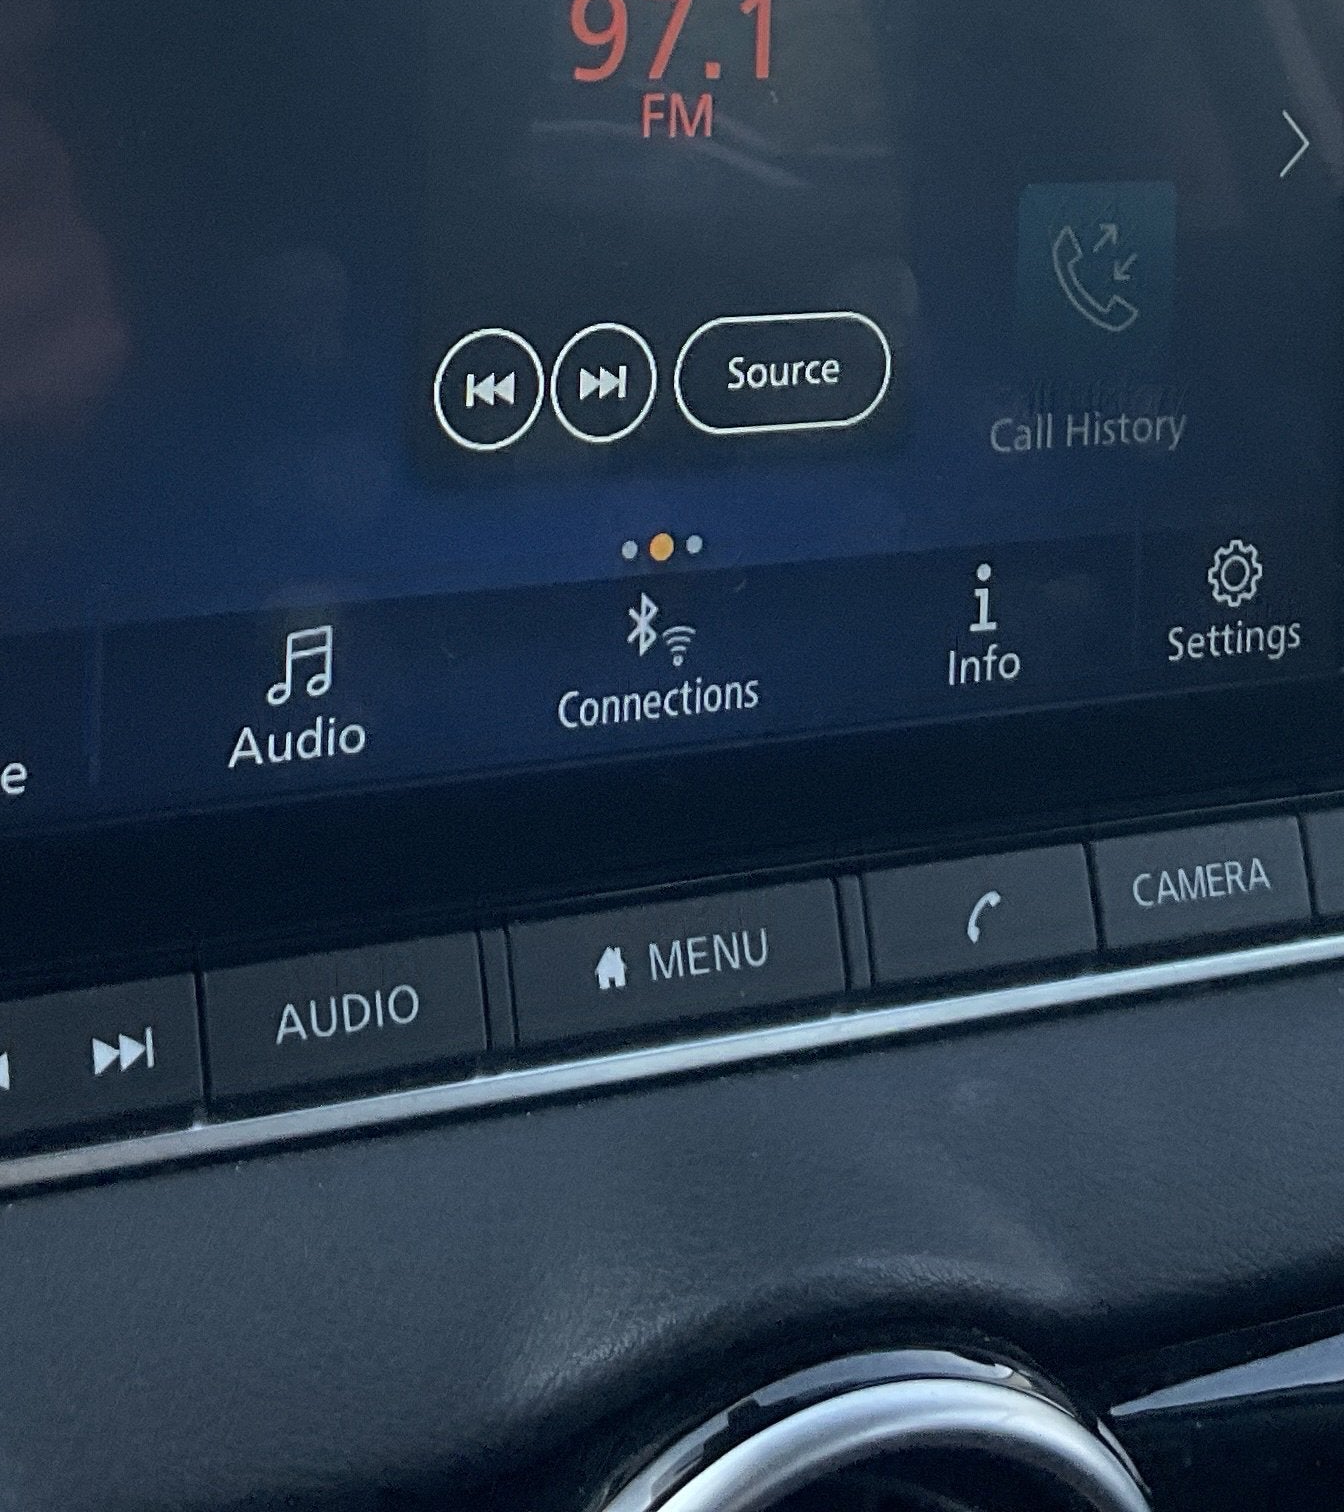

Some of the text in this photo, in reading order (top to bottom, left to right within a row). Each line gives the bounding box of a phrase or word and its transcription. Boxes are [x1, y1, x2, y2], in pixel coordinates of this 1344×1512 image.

[640, 93, 713, 138] FM
[727, 355, 840, 390] Source
[990, 409, 1187, 454] Call History
[947, 644, 1021, 686] Info
[1167, 617, 1301, 666] Settings
[557, 676, 760, 731] Connections
[228, 717, 367, 770] Audio
[1132, 856, 1272, 909] CAMERA
[648, 927, 770, 984] MENU
[275, 984, 420, 1045] AUDIO
